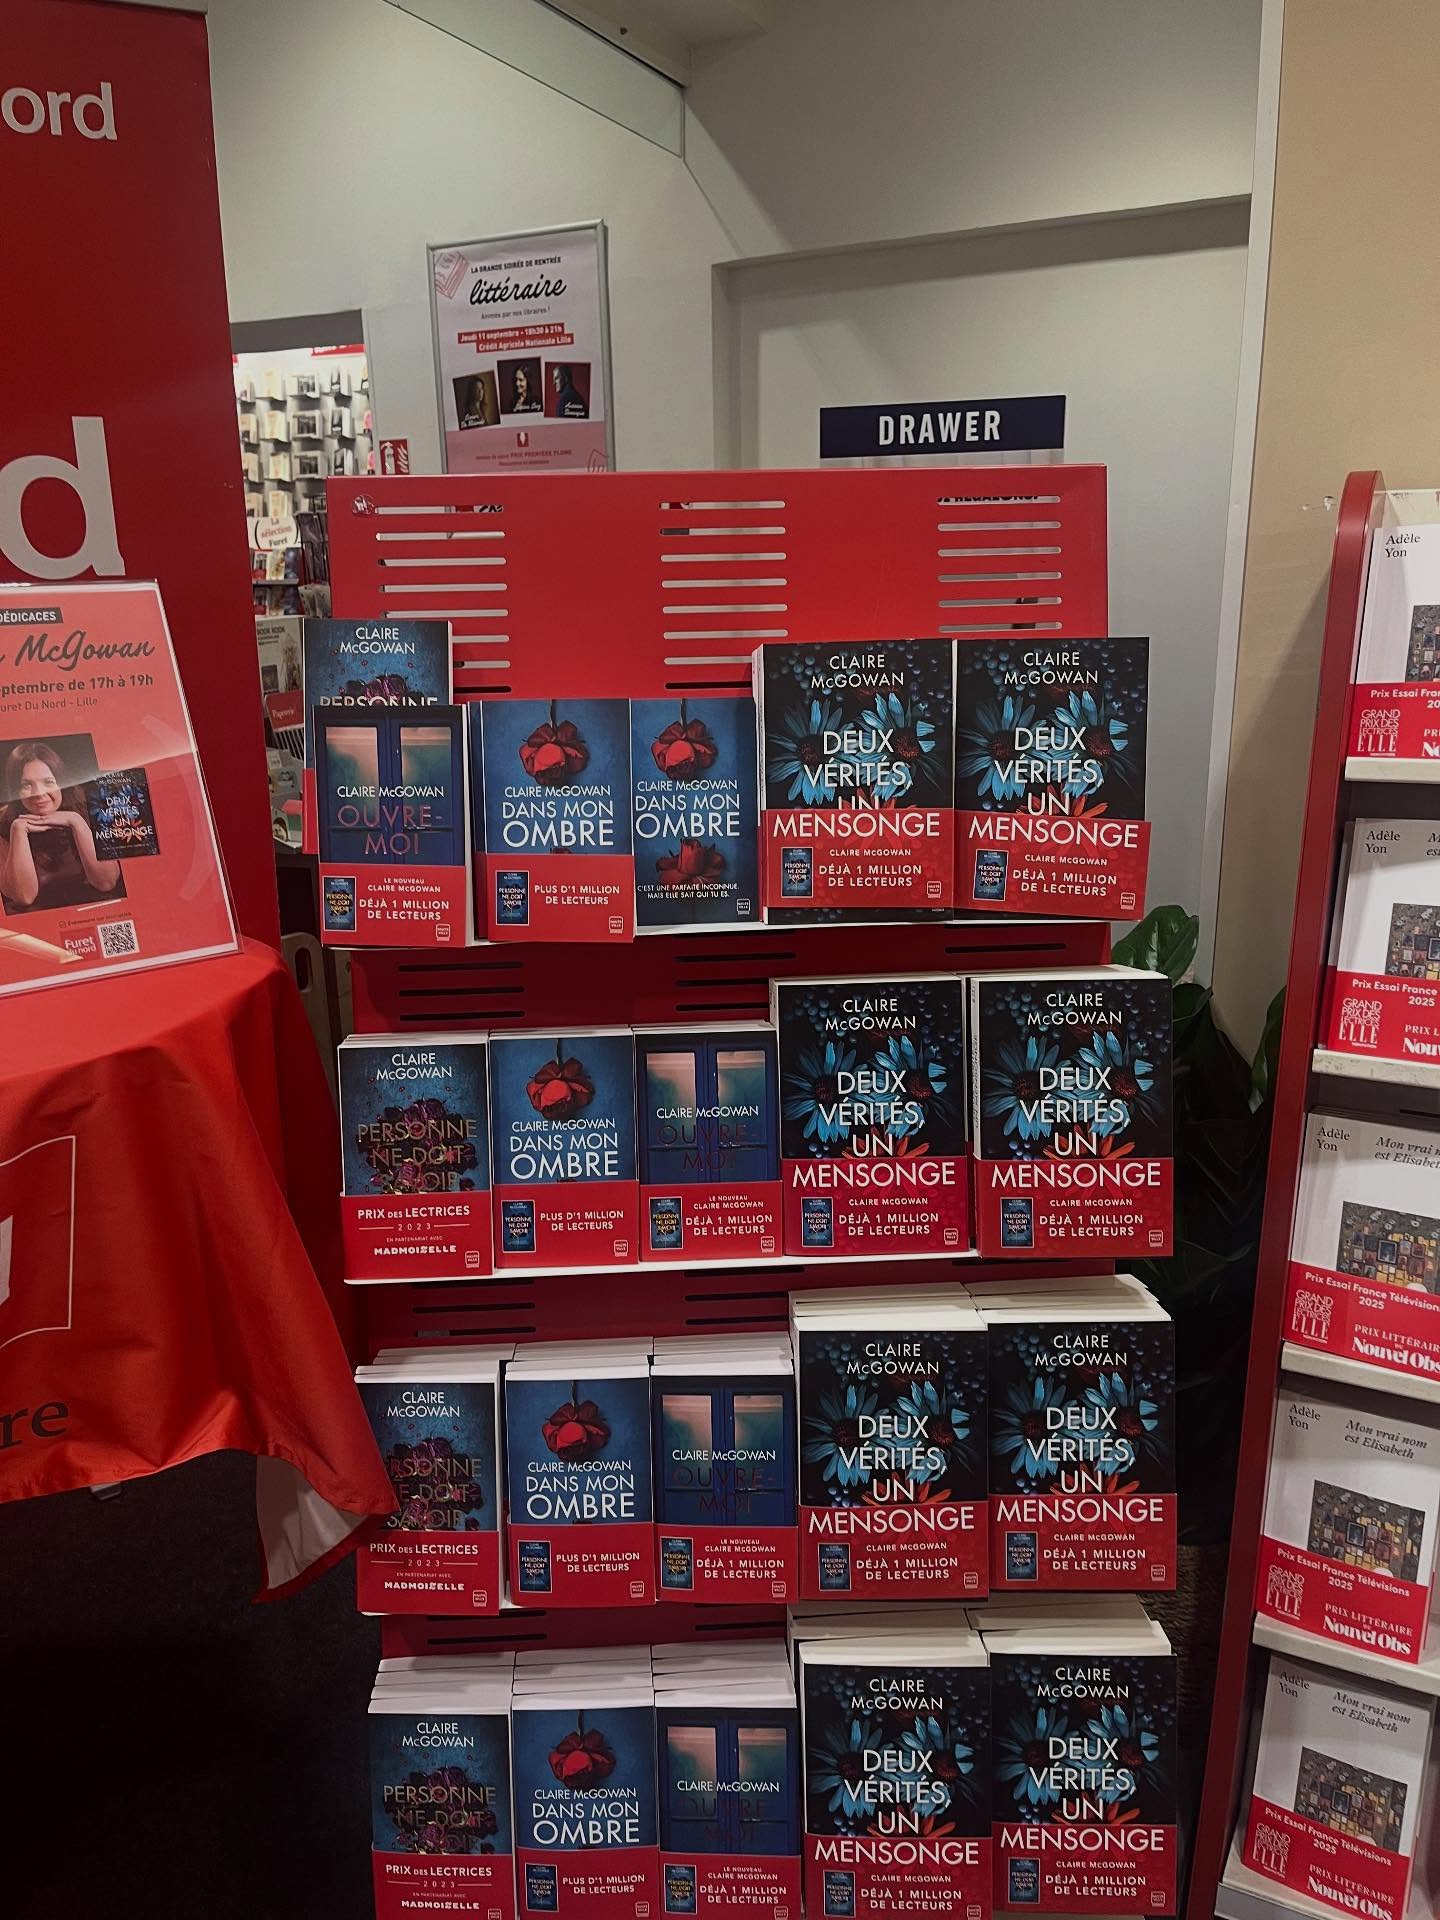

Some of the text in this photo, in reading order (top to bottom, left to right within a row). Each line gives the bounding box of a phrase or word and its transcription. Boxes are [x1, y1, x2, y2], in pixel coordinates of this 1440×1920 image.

[479, 264, 502, 272] GRANDE
[470, 274, 567, 305] littéraire
[879, 410, 1001, 446] DRAWER
[261, 525, 292, 538] sélection
[1385, 533, 1420, 545] Adèle
[269, 538, 288, 548] Furet
[1384, 547, 1407, 558] Yon
[355, 627, 400, 640] CLAIRE
[15, 630, 155, 671] McGowan
[340, 642, 415, 655] McGOWAN
[1023, 652, 1080, 666] CLAIRE
[68, 680, 85, 690] de
[90, 676, 114, 689] 17h
[118, 675, 125, 687] à
[130, 674, 153, 686] 19h
[1004, 670, 1098, 685] McGOWAN
[1370, 689, 1418, 698] Prix Essai
[25, 701, 38, 710] Du
[42, 699, 66, 709] Nord
[77, 697, 98, 707] Lille
[1361, 709, 1400, 718] GRAND
[1360, 719, 1399, 728] PRIX DES
[1014, 727, 1086, 751] DEUX
[1357, 734, 1398, 752] ELLE
[993, 753, 1104, 788] VÉRITÉS,
[337, 786, 444, 797] CLAIRE McGOWAN
[106, 796, 131, 806] DEUX
[1027, 792, 1069, 817] UN
[502, 800, 614, 819] DANS MON
[115, 816, 130, 827] UN
[95, 826, 153, 840] MENSONGE
[503, 820, 614, 848] OMBRE
[969, 816, 1139, 849] MENSONGE
[1366, 830, 1401, 842] Adèle
[365, 833, 420, 855] MOI
[1365, 843, 1387, 854] Yon
[534, 885, 565, 894] PLUS
[580, 885, 620, 894] MILLION
[359, 898, 449, 910] DÉJÀ 1 MILLION
[368, 910, 441, 921] DE LECTEURS
[65, 936, 93, 949] Furet
[1352, 979, 1438, 996] Prix Essai France
[1408, 996, 1435, 1007] 2025
[1405, 1024, 1431, 1035] PRIX
[837, 1070, 907, 1095] DEUX
[818, 1098, 924, 1128] VÉRITÉS,
[358, 1120, 477, 1142] PERSONNE
[1316, 1127, 1351, 1141] Adèle
[853, 1134, 893, 1157] UN
[1316, 1139, 1338, 1152] Yon
[1376, 1136, 1433, 1155] Mon vrai
[1374, 1151, 1390, 1161] est
[511, 1151, 619, 1179] OMBRE
[792, 1162, 956, 1188] MENSONGE
[358, 1209, 385, 1219] PRIX
[405, 1206, 470, 1218] LECTRICES
[1359, 1297, 1385, 1310] 2025
[402, 1392, 445, 1404] CLAIRE
[387, 1405, 460, 1417] McGOWAN
[1046, 1407, 1117, 1430] DEUX
[1289, 1403, 1321, 1421] Adèle
[1288, 1415, 1309, 1430] Yon
[1345, 1420, 1428, 1448] Mon vrai nom
[1027, 1433, 1135, 1468] VÉRITÉS,
[1344, 1433, 1415, 1459] est Elisabeth
[1061, 1470, 1102, 1494] UN
[526, 1492, 635, 1520] OMBRE
[996, 1499, 1163, 1523] MENSONGE
[1277, 1548, 1410, 1597] Prix Essai France Télévisions
[1328, 1576, 1353, 1591] 2025
[1325, 1603, 1350, 1617] PRIX
[1378, 1633, 1411, 1655] Obs
[1280, 1671, 1311, 1690] Adèle
[1279, 1682, 1299, 1698] Yon
[417, 1722, 458, 1735] CLAIRE
[402, 1736, 474, 1748] McGOWAN
[1049, 1737, 1119, 1761] DEUX
[384, 1785, 496, 1804] PERSONNE
[533, 1819, 640, 1845] OMBRE
[815, 1840, 979, 1865] MENSONGE
[1313, 1839, 1336, 1855] 2025
[386, 1865, 492, 1877] PRIX LECTRICES
[742, 1887, 786, 1895] MILLION
[725, 1896, 779, 1904] LECTEURS
